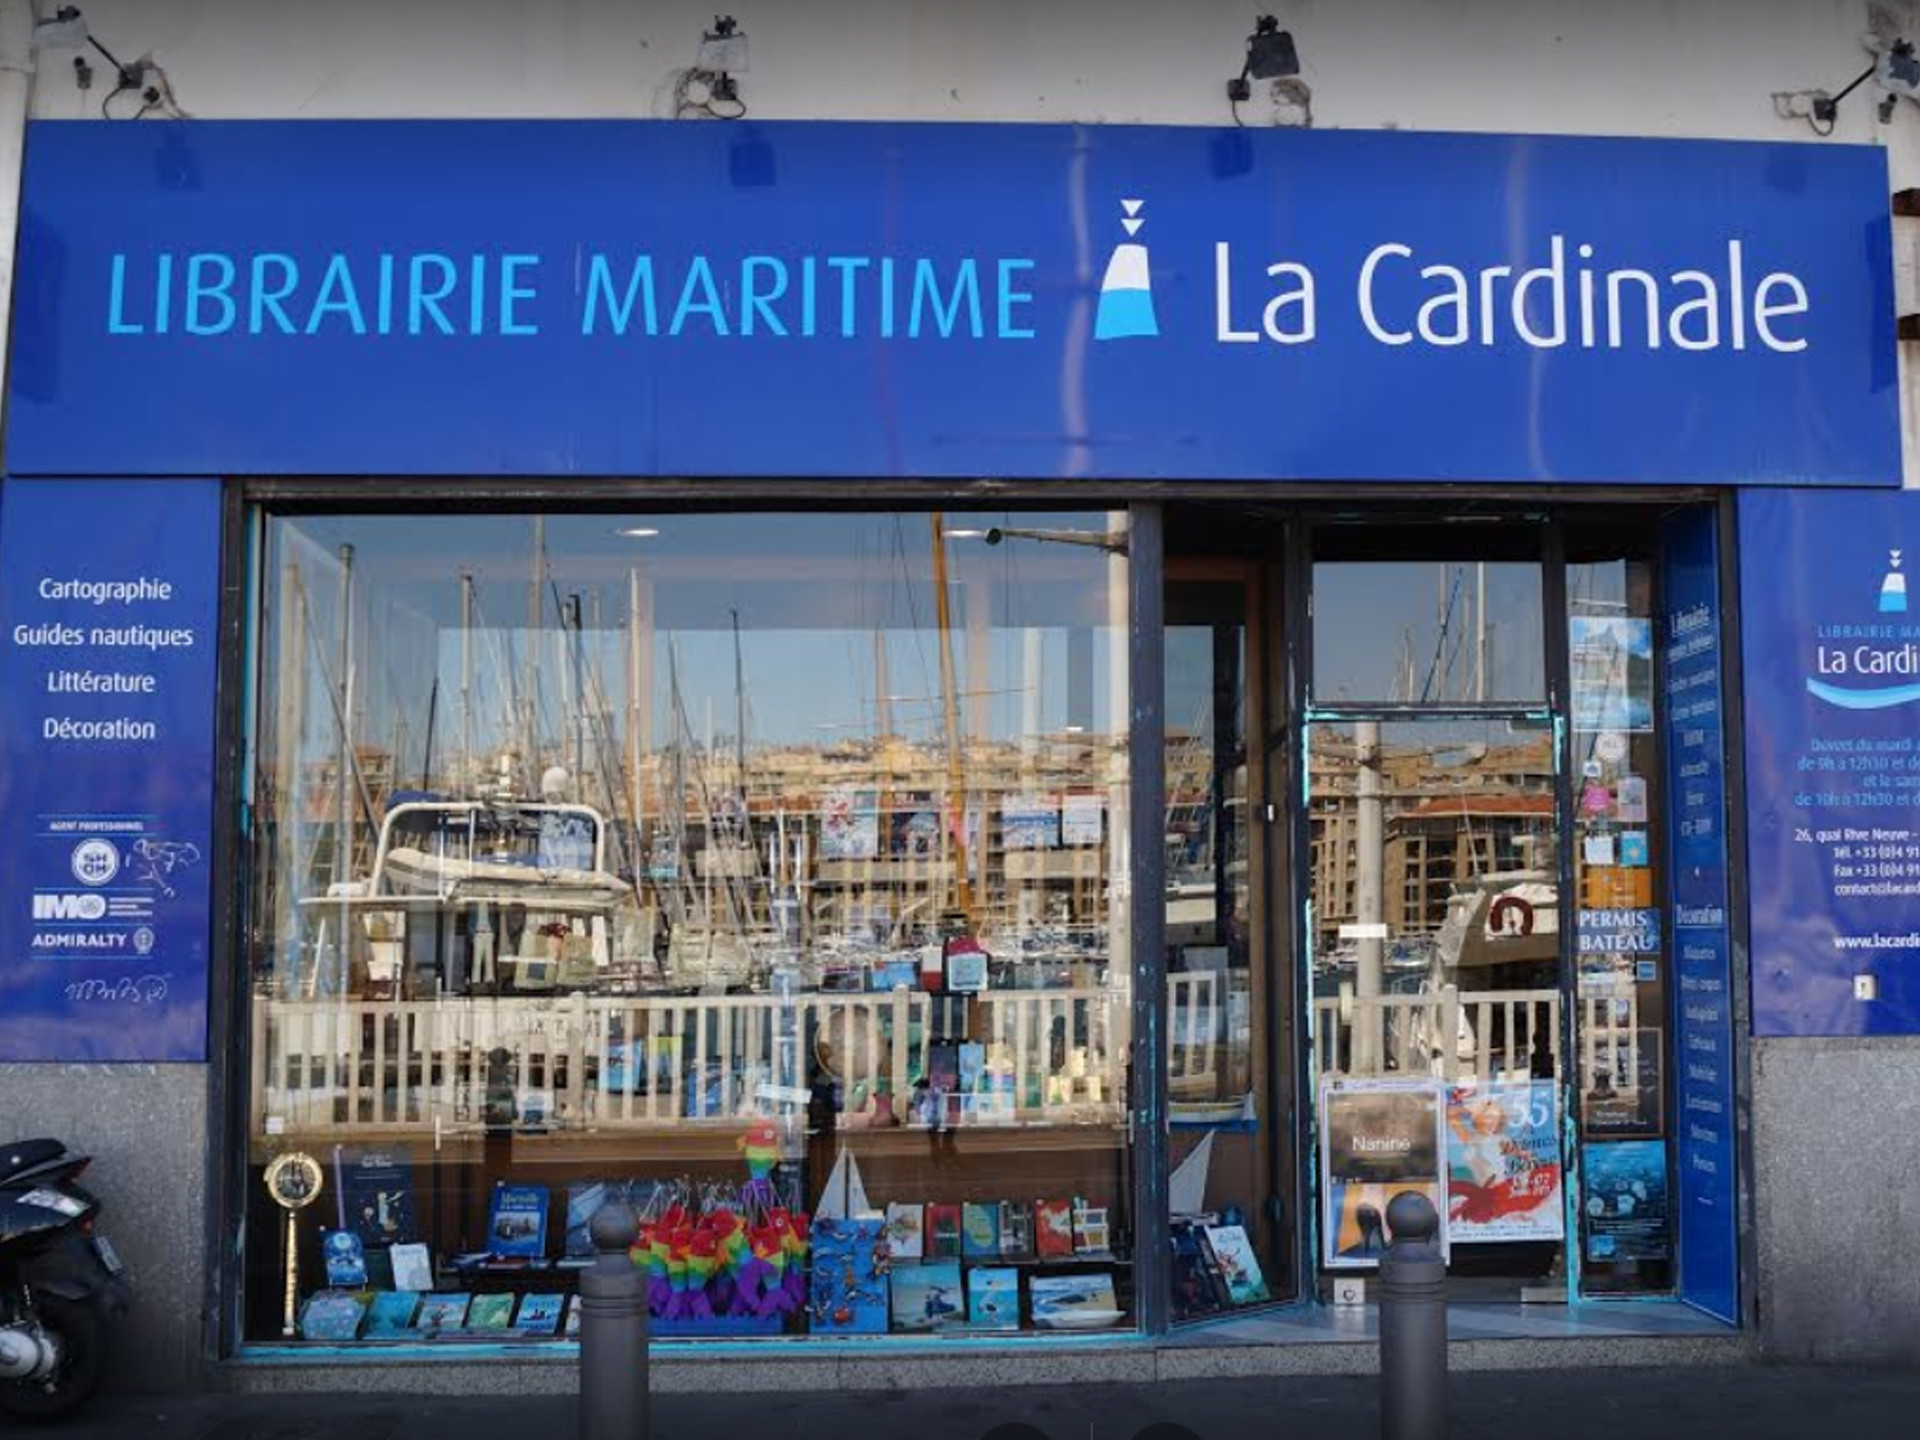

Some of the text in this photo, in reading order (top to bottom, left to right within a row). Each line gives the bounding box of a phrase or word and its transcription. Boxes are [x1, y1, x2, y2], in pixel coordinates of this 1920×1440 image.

[108, 253, 1035, 339] LIBRAIRIE MARITIME
[1215, 234, 1809, 353] La Cardinale
[39, 577, 172, 604] Cartographie
[13, 623, 194, 650] Guides nautiques
[1818, 624, 1893, 638] LIBRAIRIE
[1818, 643, 1918, 674] La Cardi
[47, 670, 155, 692] Littérature
[43, 717, 156, 739] Décoration
[1795, 792, 1812, 805] de
[1795, 829, 1814, 842] 26,
[1816, 829, 1842, 843] quai
[1844, 829, 1869, 841] Rive
[1872, 828, 1909, 841] Neuve
[1834, 863, 1854, 877] Fax
[33, 894, 106, 919] IMO
[1579, 909, 1647, 927] PERMIS
[32, 933, 127, 947] ADMIRALTY
[1579, 934, 1655, 951] BATEAU
